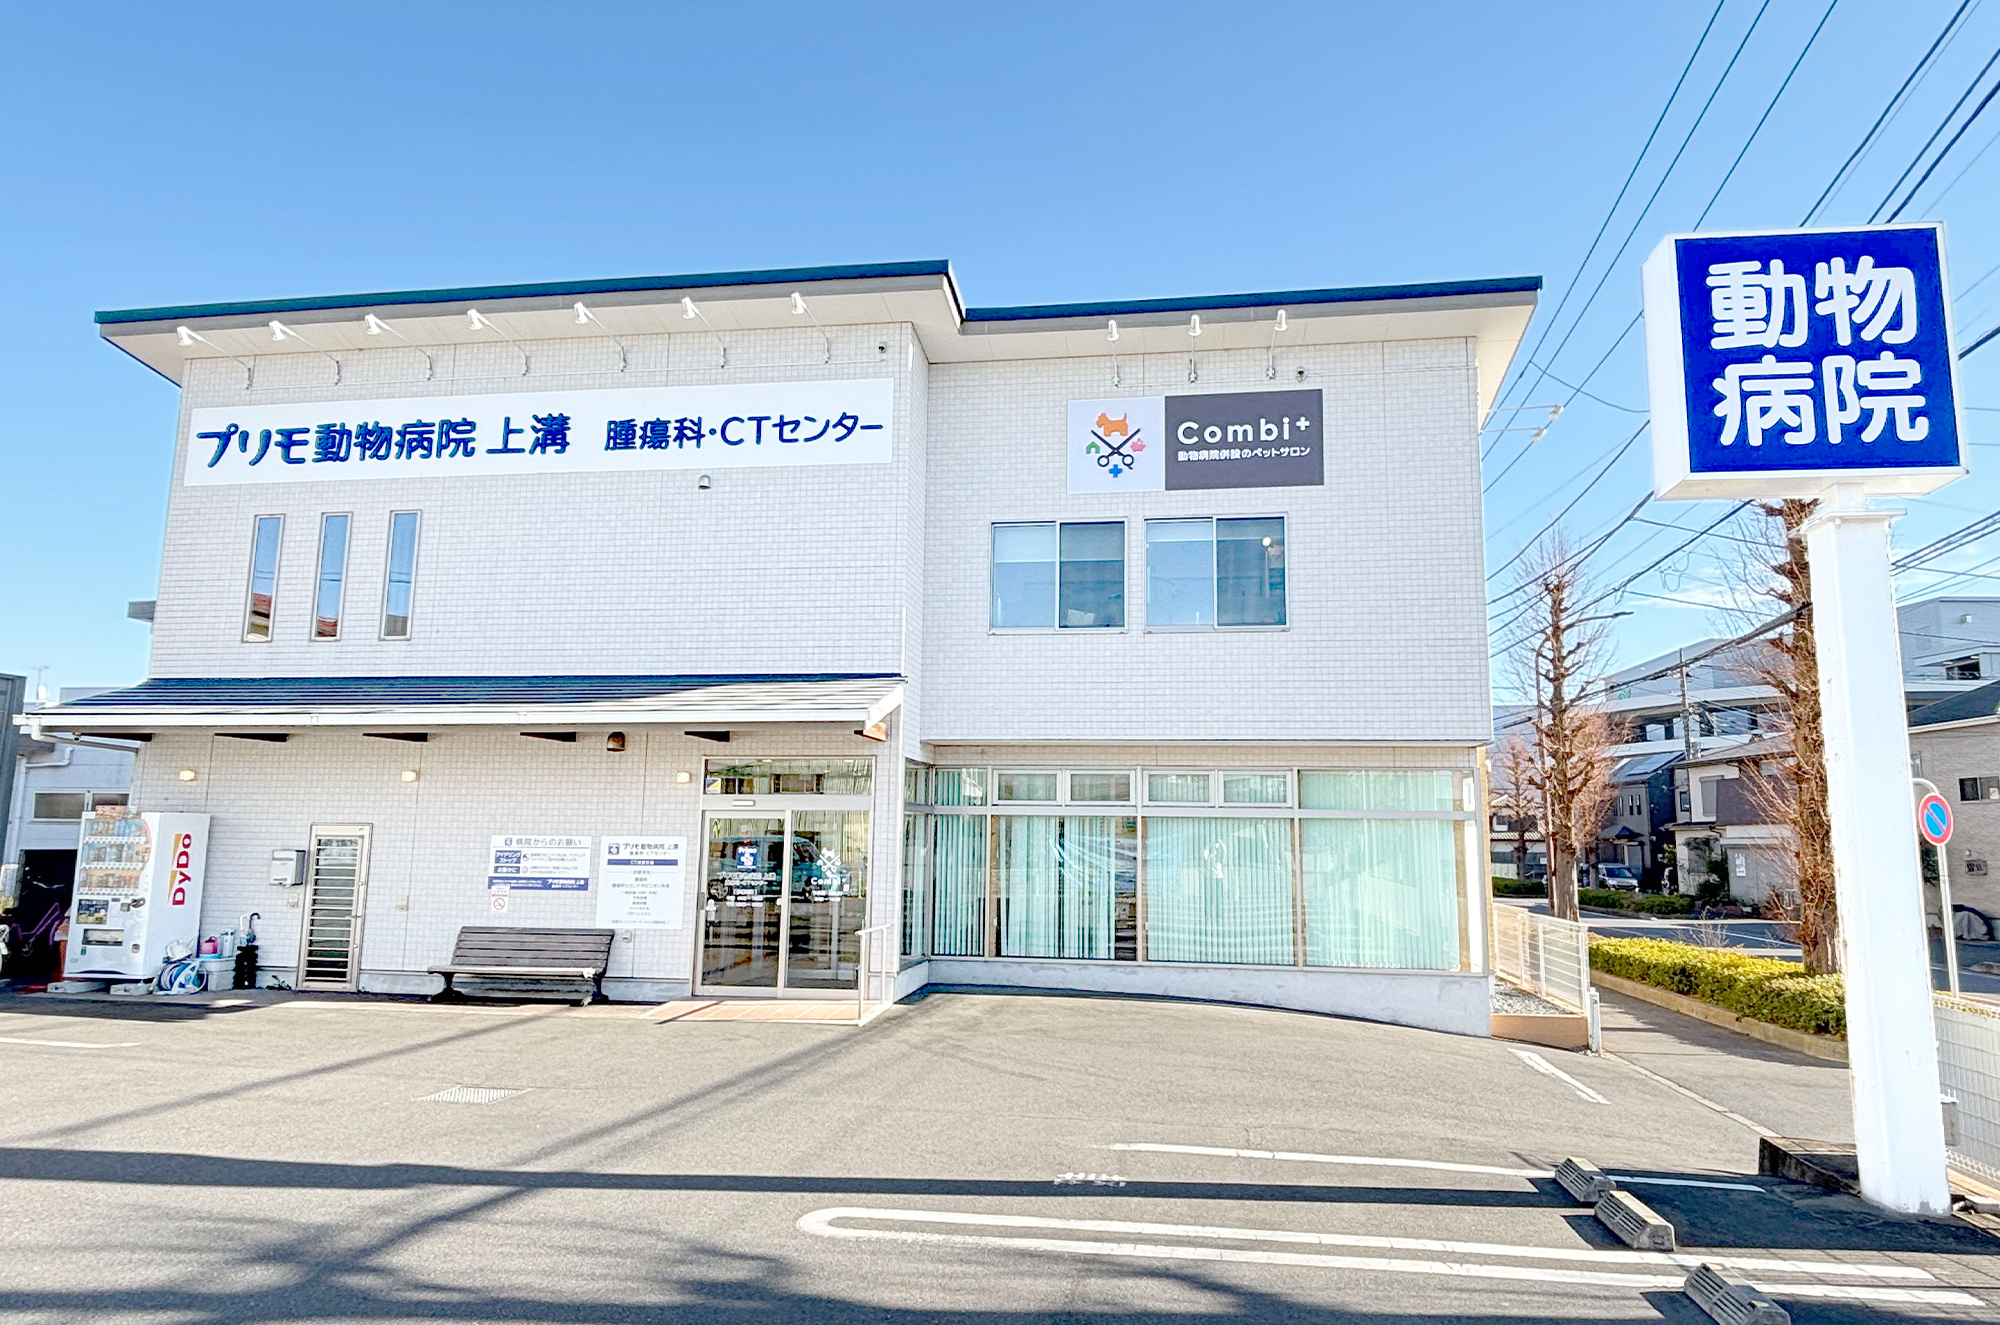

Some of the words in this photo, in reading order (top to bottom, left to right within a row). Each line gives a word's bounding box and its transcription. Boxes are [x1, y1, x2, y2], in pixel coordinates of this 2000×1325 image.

[1706, 255, 1917, 349] 動物
[1712, 351, 1929, 446] 病院
[196, 420, 475, 468] プリモ動物病院
[486, 414, 570, 456] 上溝
[604, 414, 884, 452] 腫瘍科・CTセンター
[1177, 446, 1311, 462] 動物病院併設のペットサロン
[172, 833, 193, 905] DyDo
[516, 838, 582, 846] 病院からのお願い
